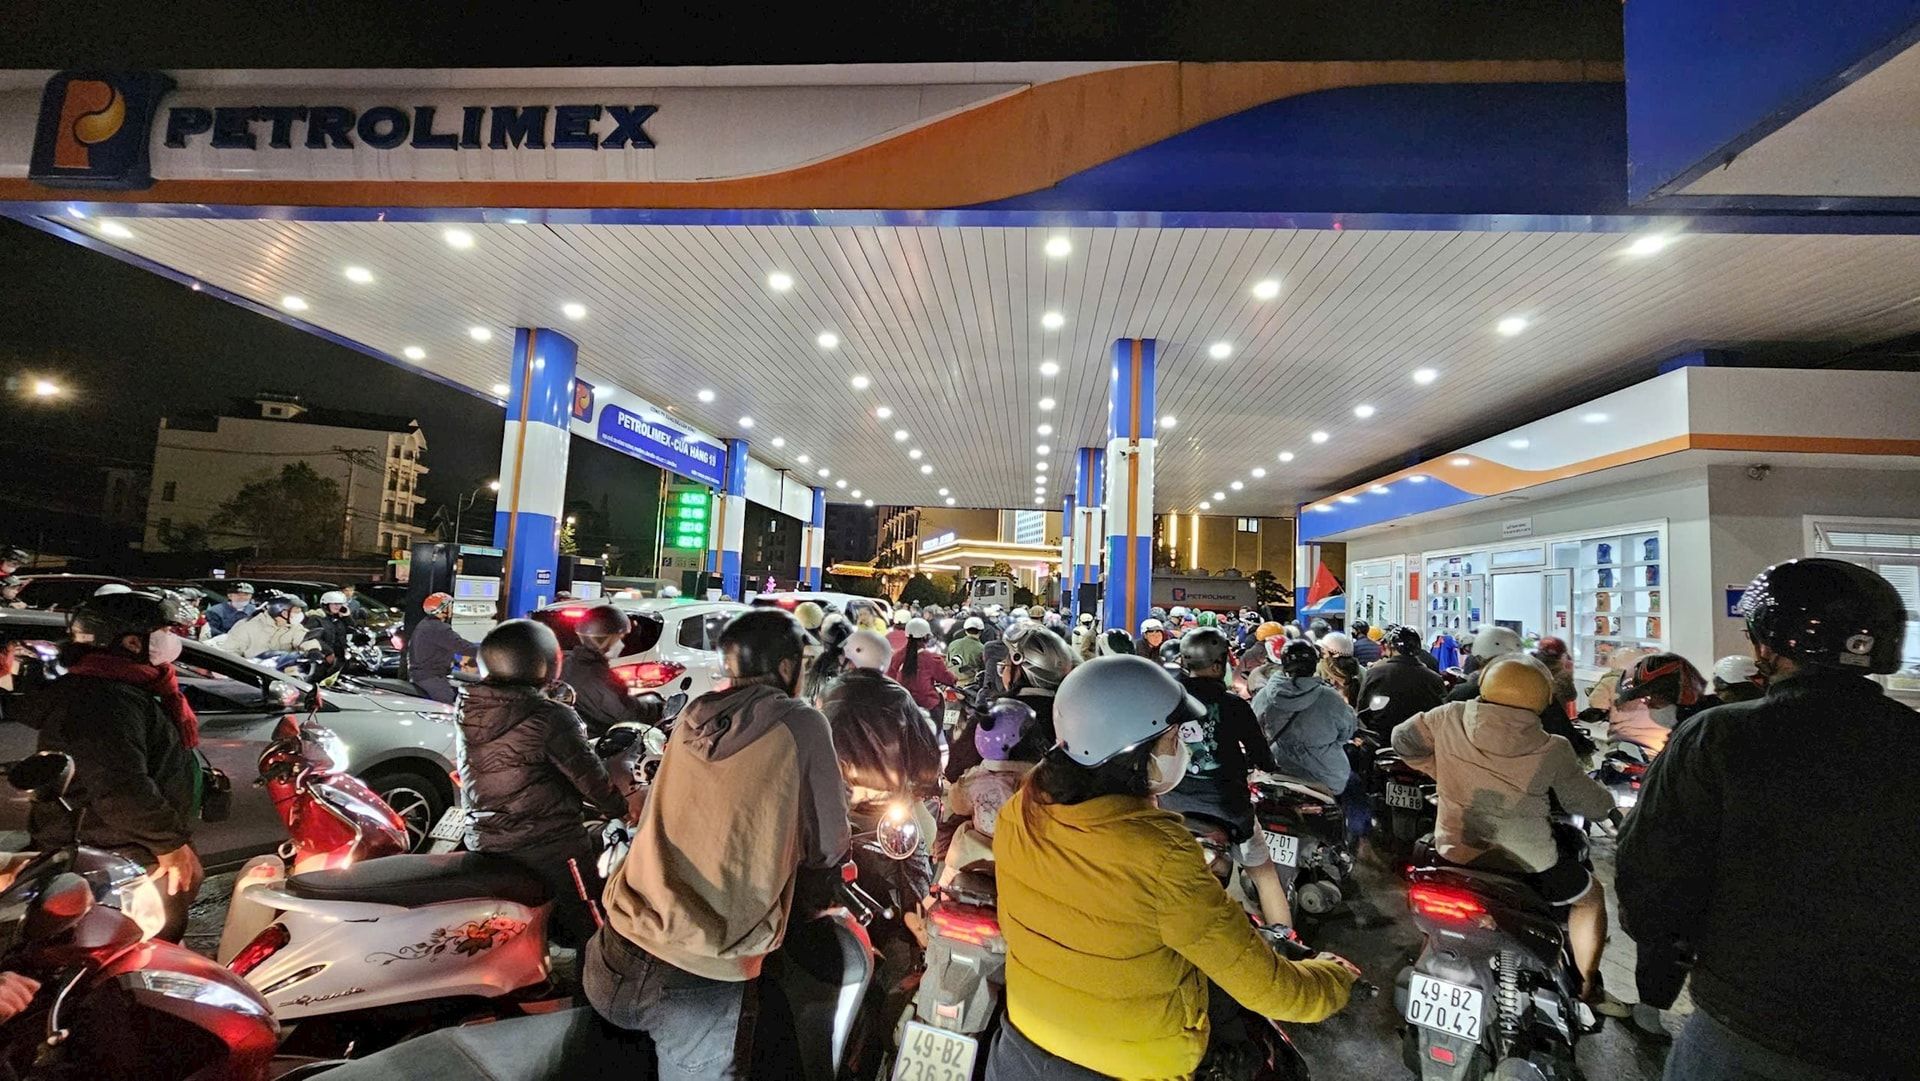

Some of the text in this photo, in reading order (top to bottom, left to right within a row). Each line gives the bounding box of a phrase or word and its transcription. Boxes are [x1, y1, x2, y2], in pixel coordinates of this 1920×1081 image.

[164, 105, 658, 150] PETROLIMEX
[1421, 979, 1472, 1011] 49-B2
[1411, 999, 1477, 1038] 070.42
[913, 1030, 965, 1068] 49-B2
